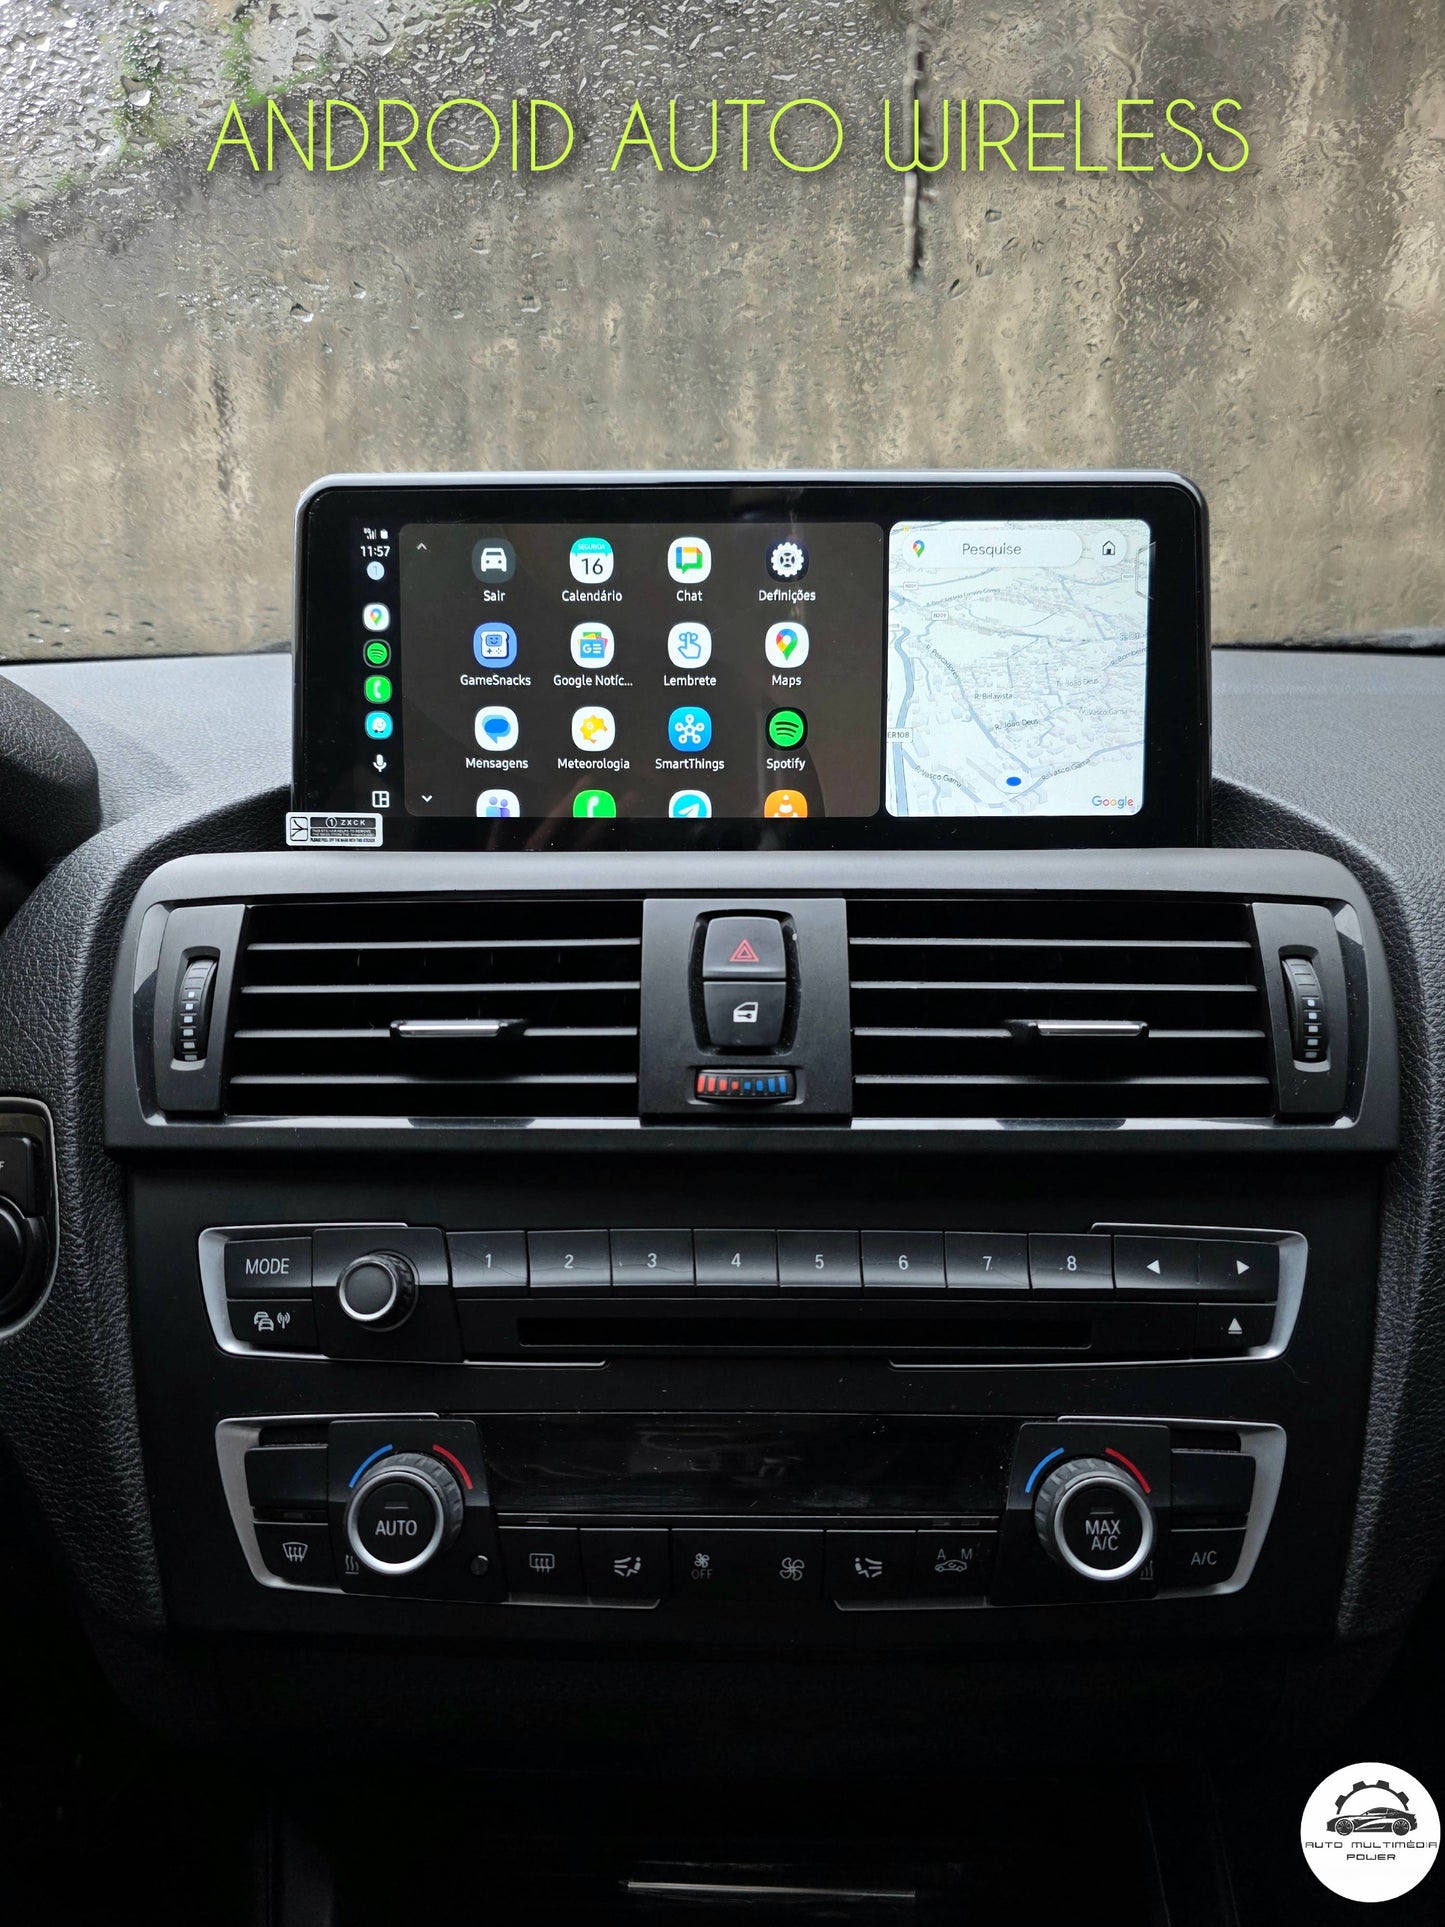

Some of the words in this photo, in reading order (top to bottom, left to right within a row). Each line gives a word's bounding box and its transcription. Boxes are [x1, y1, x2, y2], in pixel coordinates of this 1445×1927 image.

[360, 545, 390, 557] 11:57
[962, 543, 1022, 558] Pesquise
[581, 558, 604, 575] 16
[483, 590, 506, 602] Sair
[561, 590, 623, 602] Calendário
[676, 590, 703, 602] Chat
[758, 589, 817, 604] Definições
[460, 675, 532, 686] GameSnacks
[553, 674, 592, 688] Google
[663, 674, 717, 686] Lembrete
[771, 675, 802, 688] Maps
[465, 757, 529, 771] Mensagens
[557, 757, 630, 771] Meteorologia
[655, 758, 725, 772] SmartThings
[766, 757, 806, 771] Spotify
[1092, 795, 1134, 809] Google
[245, 1258, 290, 1275] MODE
[485, 1253, 493, 1268] 1
[564, 1254, 574, 1269] 2
[647, 1253, 657, 1268] 3
[730, 1253, 741, 1268] 4
[815, 1254, 824, 1270] 5
[898, 1255, 908, 1271] 6
[982, 1256, 992, 1271] 7
[1066, 1256, 1077, 1272] 8
[375, 1519, 418, 1536] AUTO
[1085, 1519, 1121, 1535] MAX
[1091, 1535, 1119, 1552] A/C
[936, 1548, 946, 1560] A
[961, 1547, 973, 1559] M
[1190, 1550, 1217, 1566] A/C
[691, 1569, 713, 1580] OFF
